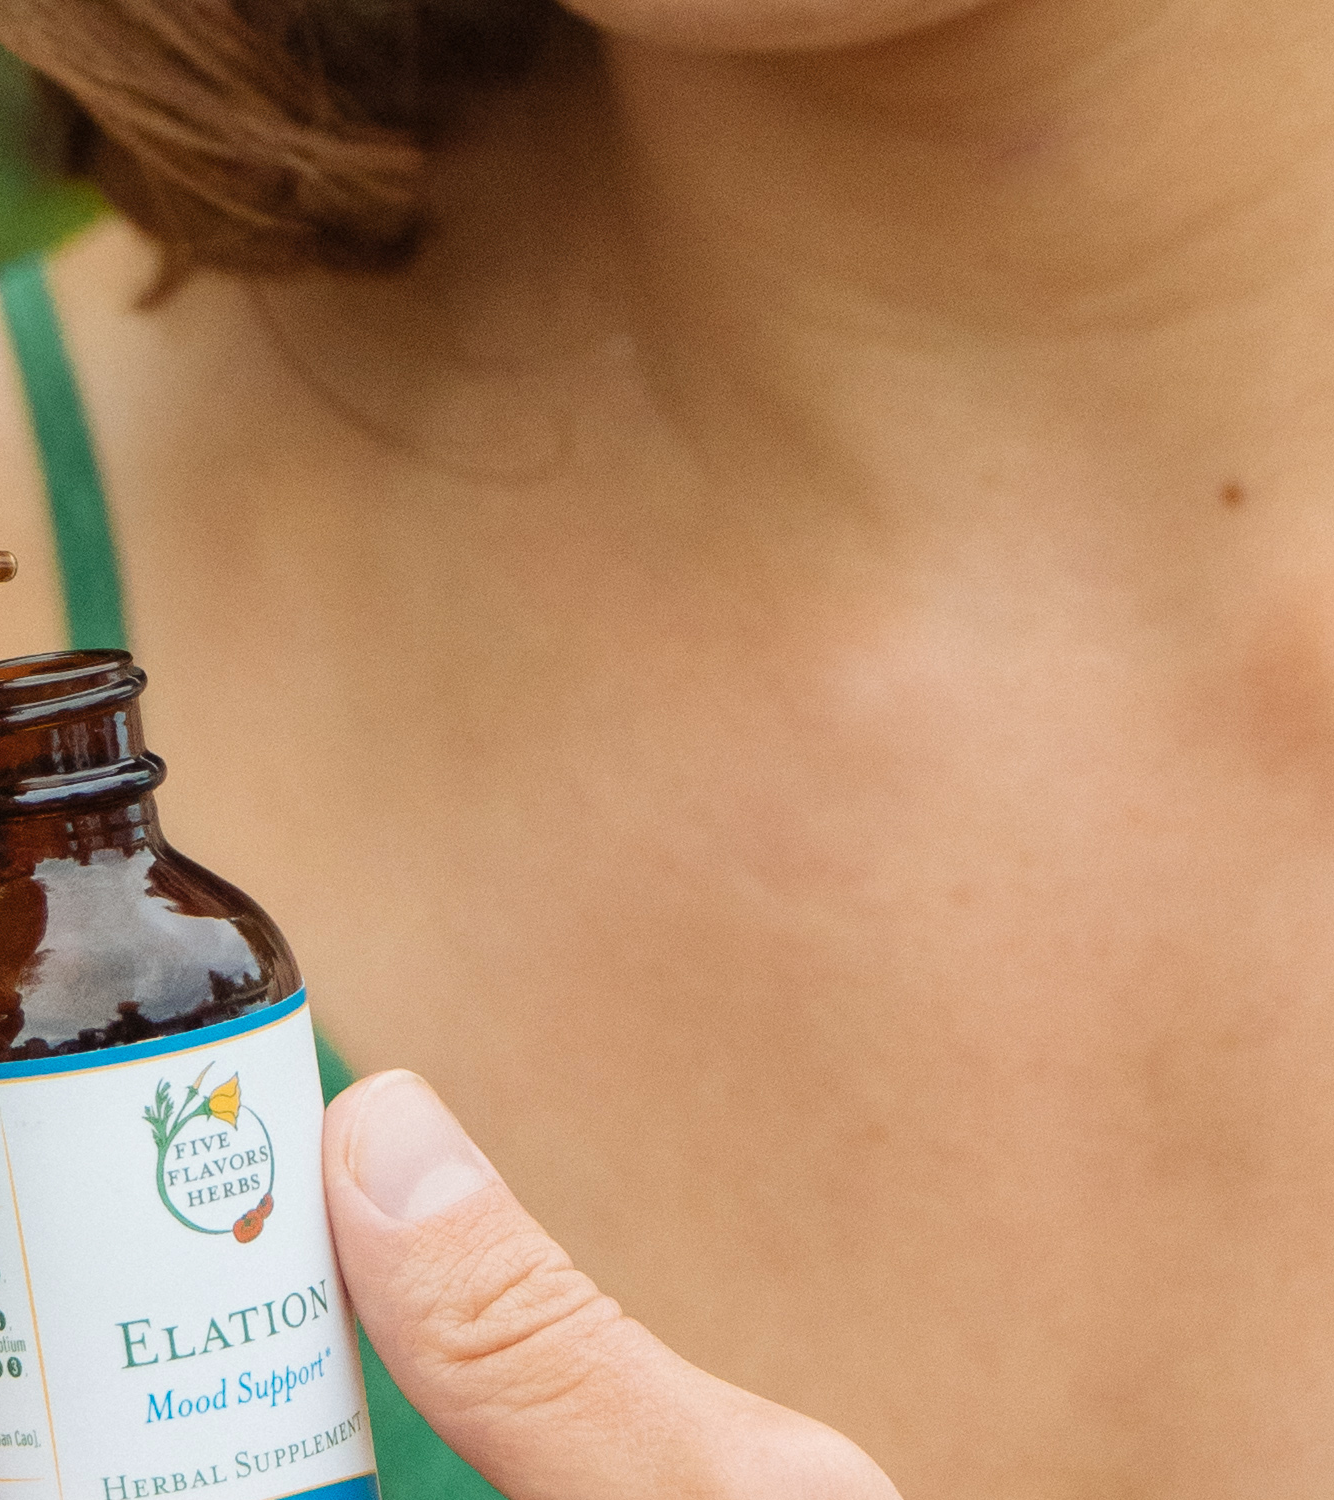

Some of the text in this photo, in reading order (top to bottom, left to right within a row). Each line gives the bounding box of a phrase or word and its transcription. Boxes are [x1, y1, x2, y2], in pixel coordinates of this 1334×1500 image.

[173, 1131, 231, 1161] FIVE
[167, 1145, 269, 1187] FLAVORS
[187, 1173, 261, 1208] HERBS
[145, 1377, 228, 1425] Mood
